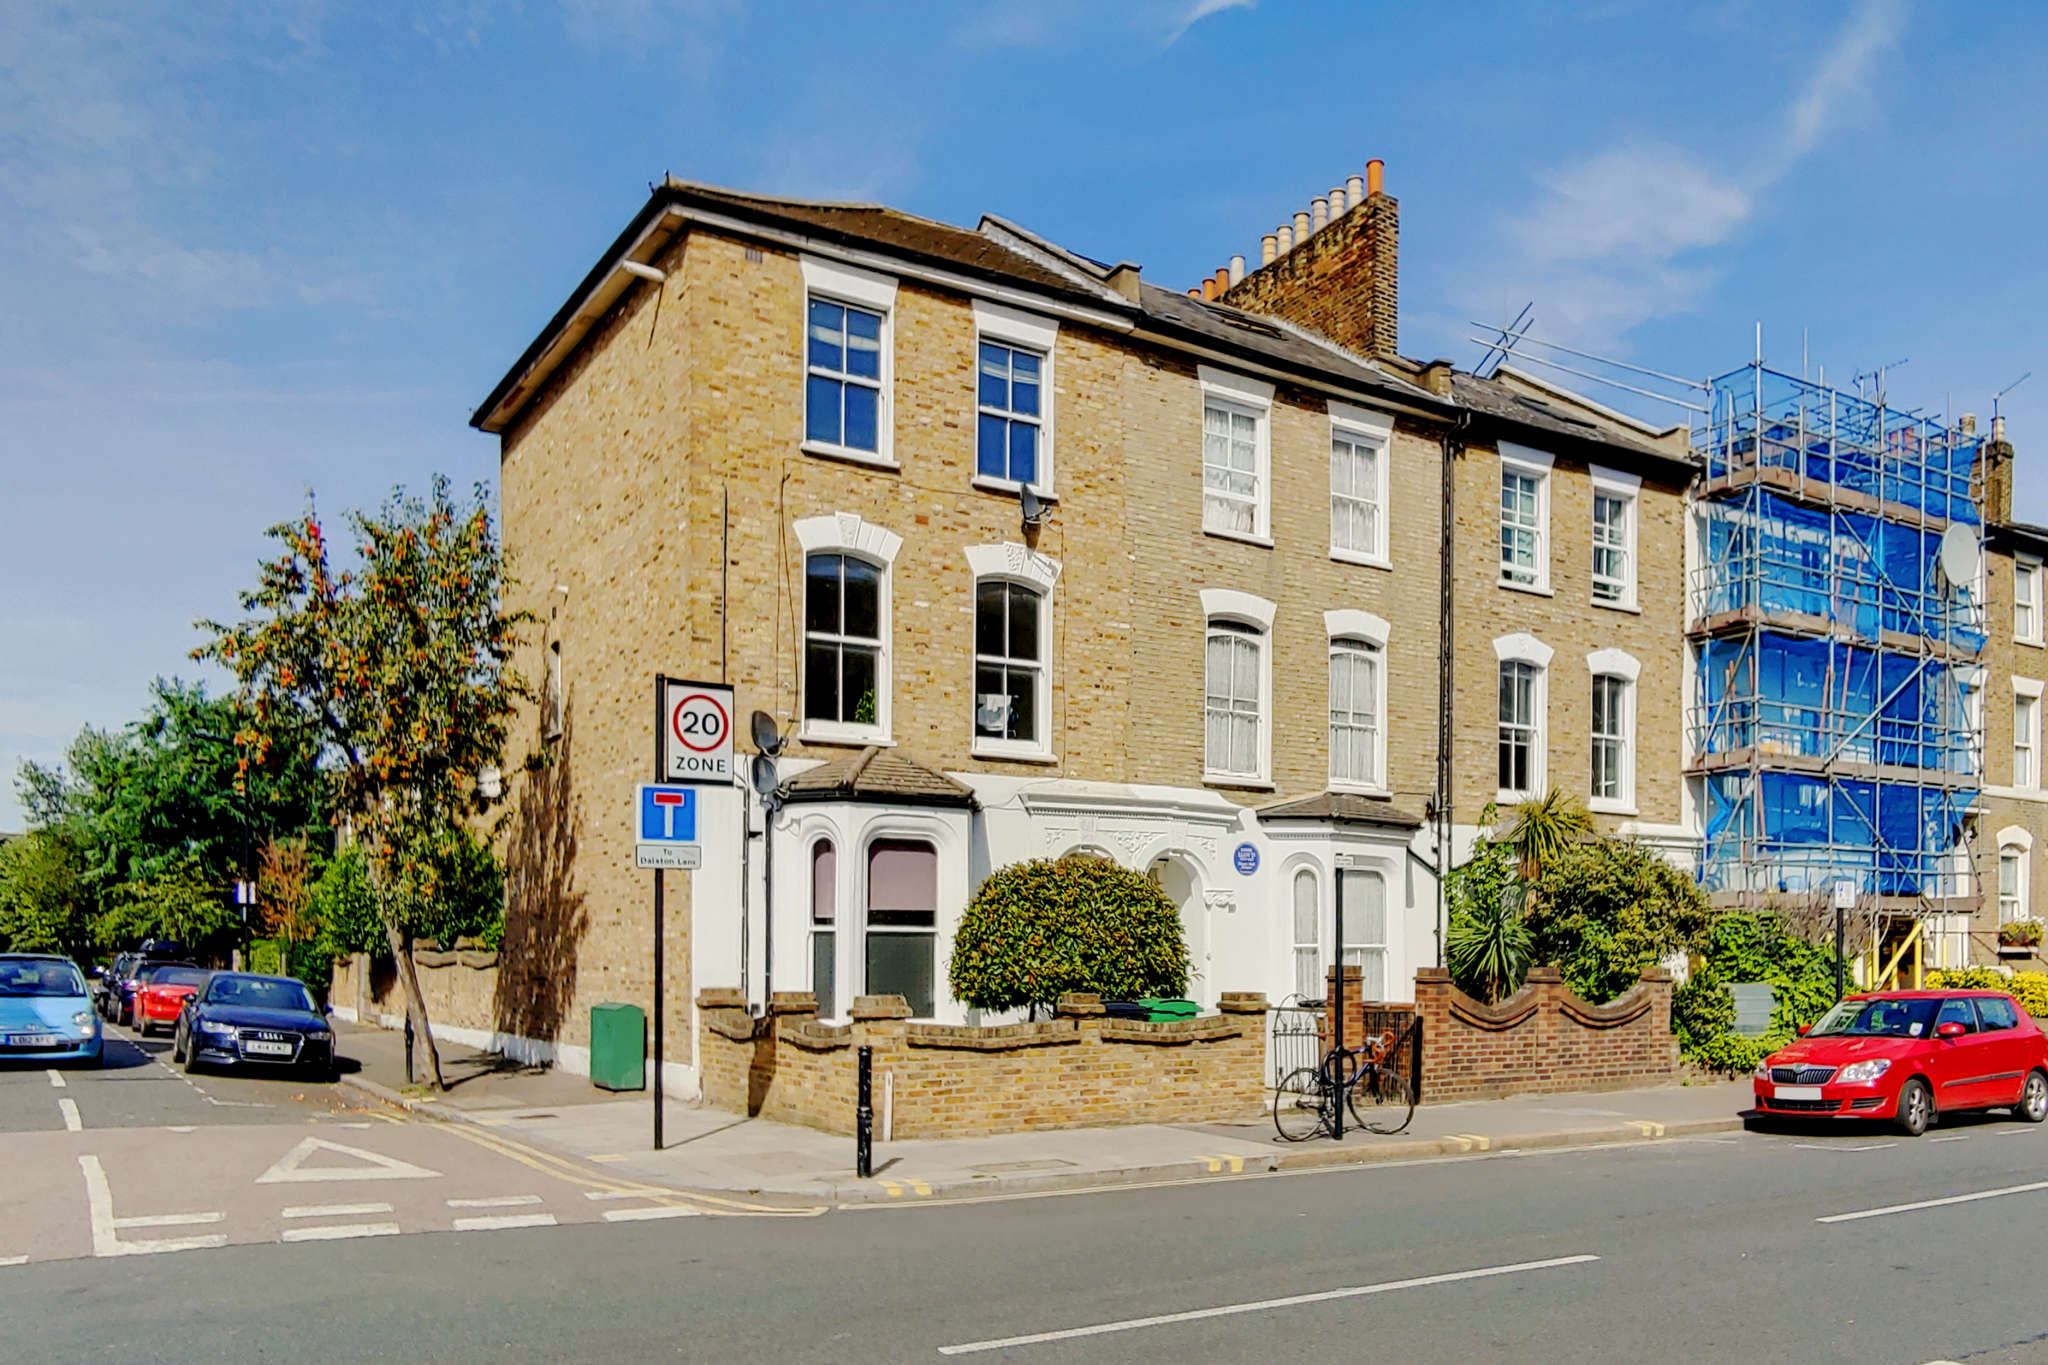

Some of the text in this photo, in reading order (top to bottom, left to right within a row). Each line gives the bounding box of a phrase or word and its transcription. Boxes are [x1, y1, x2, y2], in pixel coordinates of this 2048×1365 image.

[683, 712, 719, 735] 20
[676, 756, 726, 773] ZONE
[663, 848, 673, 857] To
[640, 856, 696, 866] Dalston Lane
